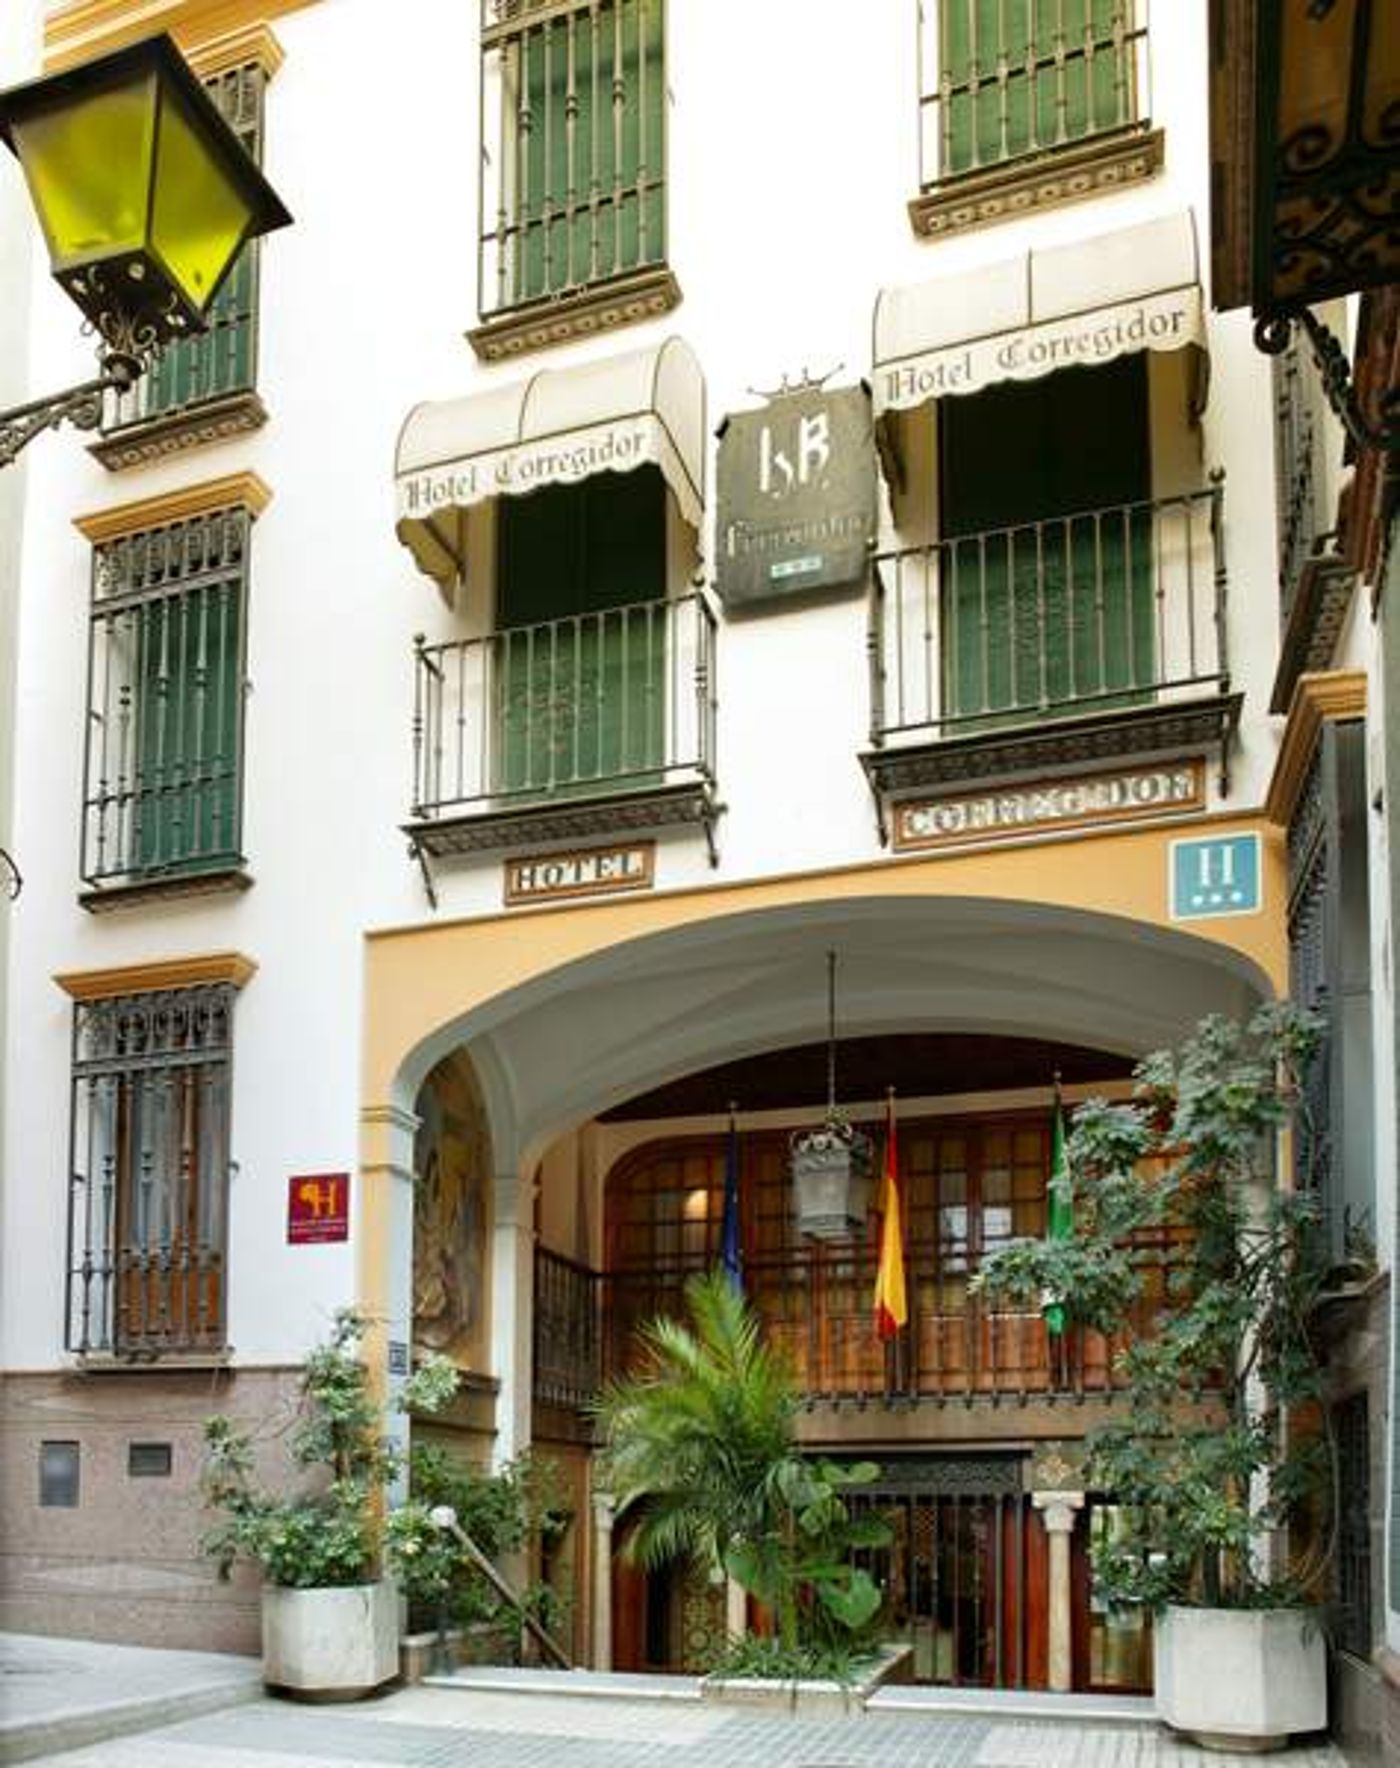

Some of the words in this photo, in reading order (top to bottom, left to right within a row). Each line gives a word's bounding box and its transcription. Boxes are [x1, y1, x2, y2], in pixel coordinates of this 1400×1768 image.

[886, 352, 972, 401] Hotel
[996, 309, 1186, 369] Corregidor
[404, 466, 476, 509] Hotel
[494, 431, 646, 485] Corregidor
[517, 852, 641, 888] HOTEL
